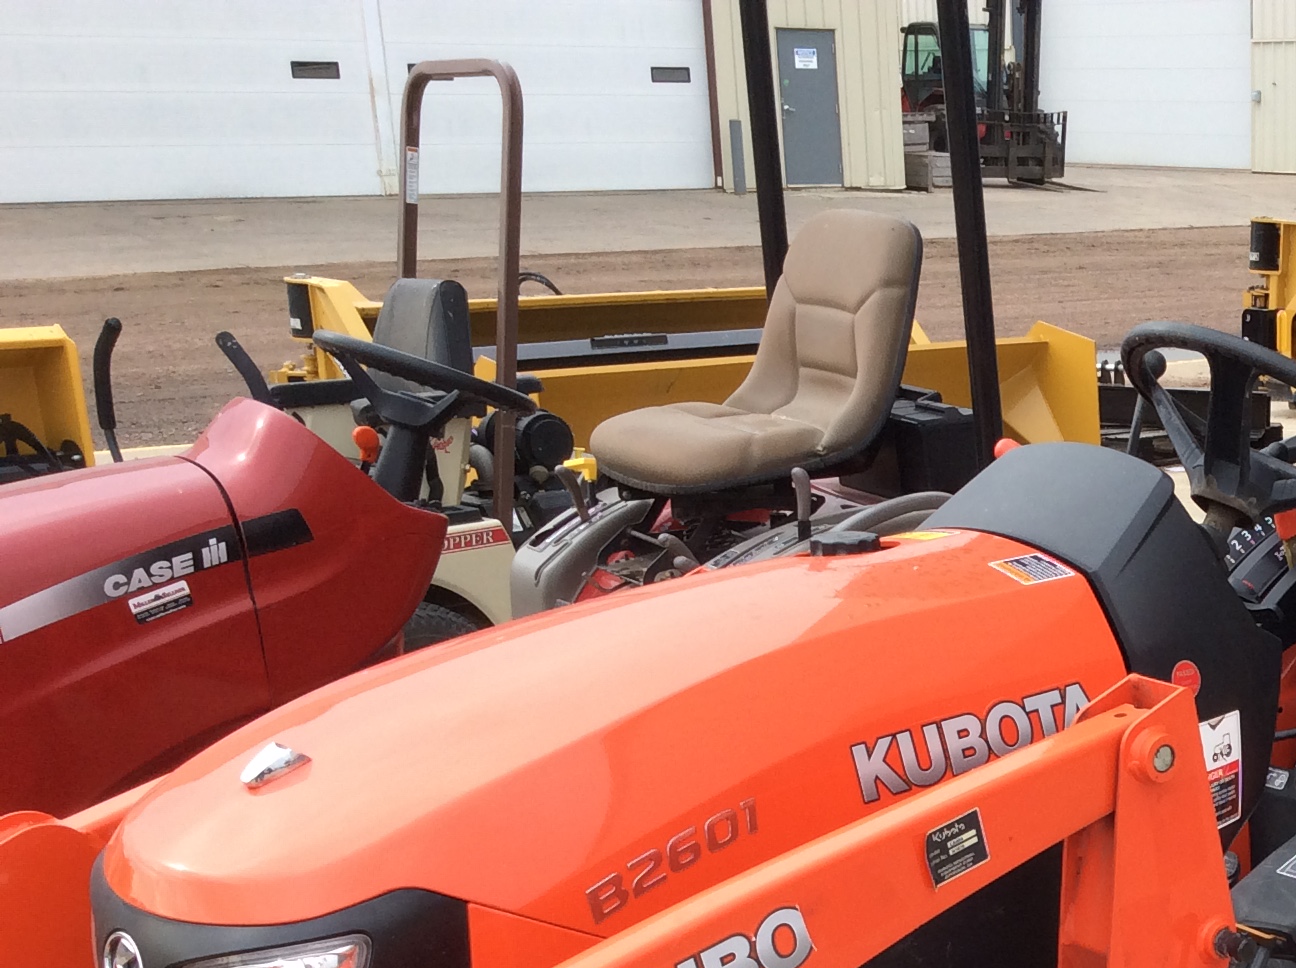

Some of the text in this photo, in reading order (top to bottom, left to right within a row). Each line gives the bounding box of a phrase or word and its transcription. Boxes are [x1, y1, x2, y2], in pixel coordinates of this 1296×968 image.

[103, 551, 195, 598] CASE
[1231, 540, 1242, 550] 2
[1241, 530, 1252, 541] 3
[850, 682, 1091, 804] KUBOTA
[585, 797, 758, 924] B2601
